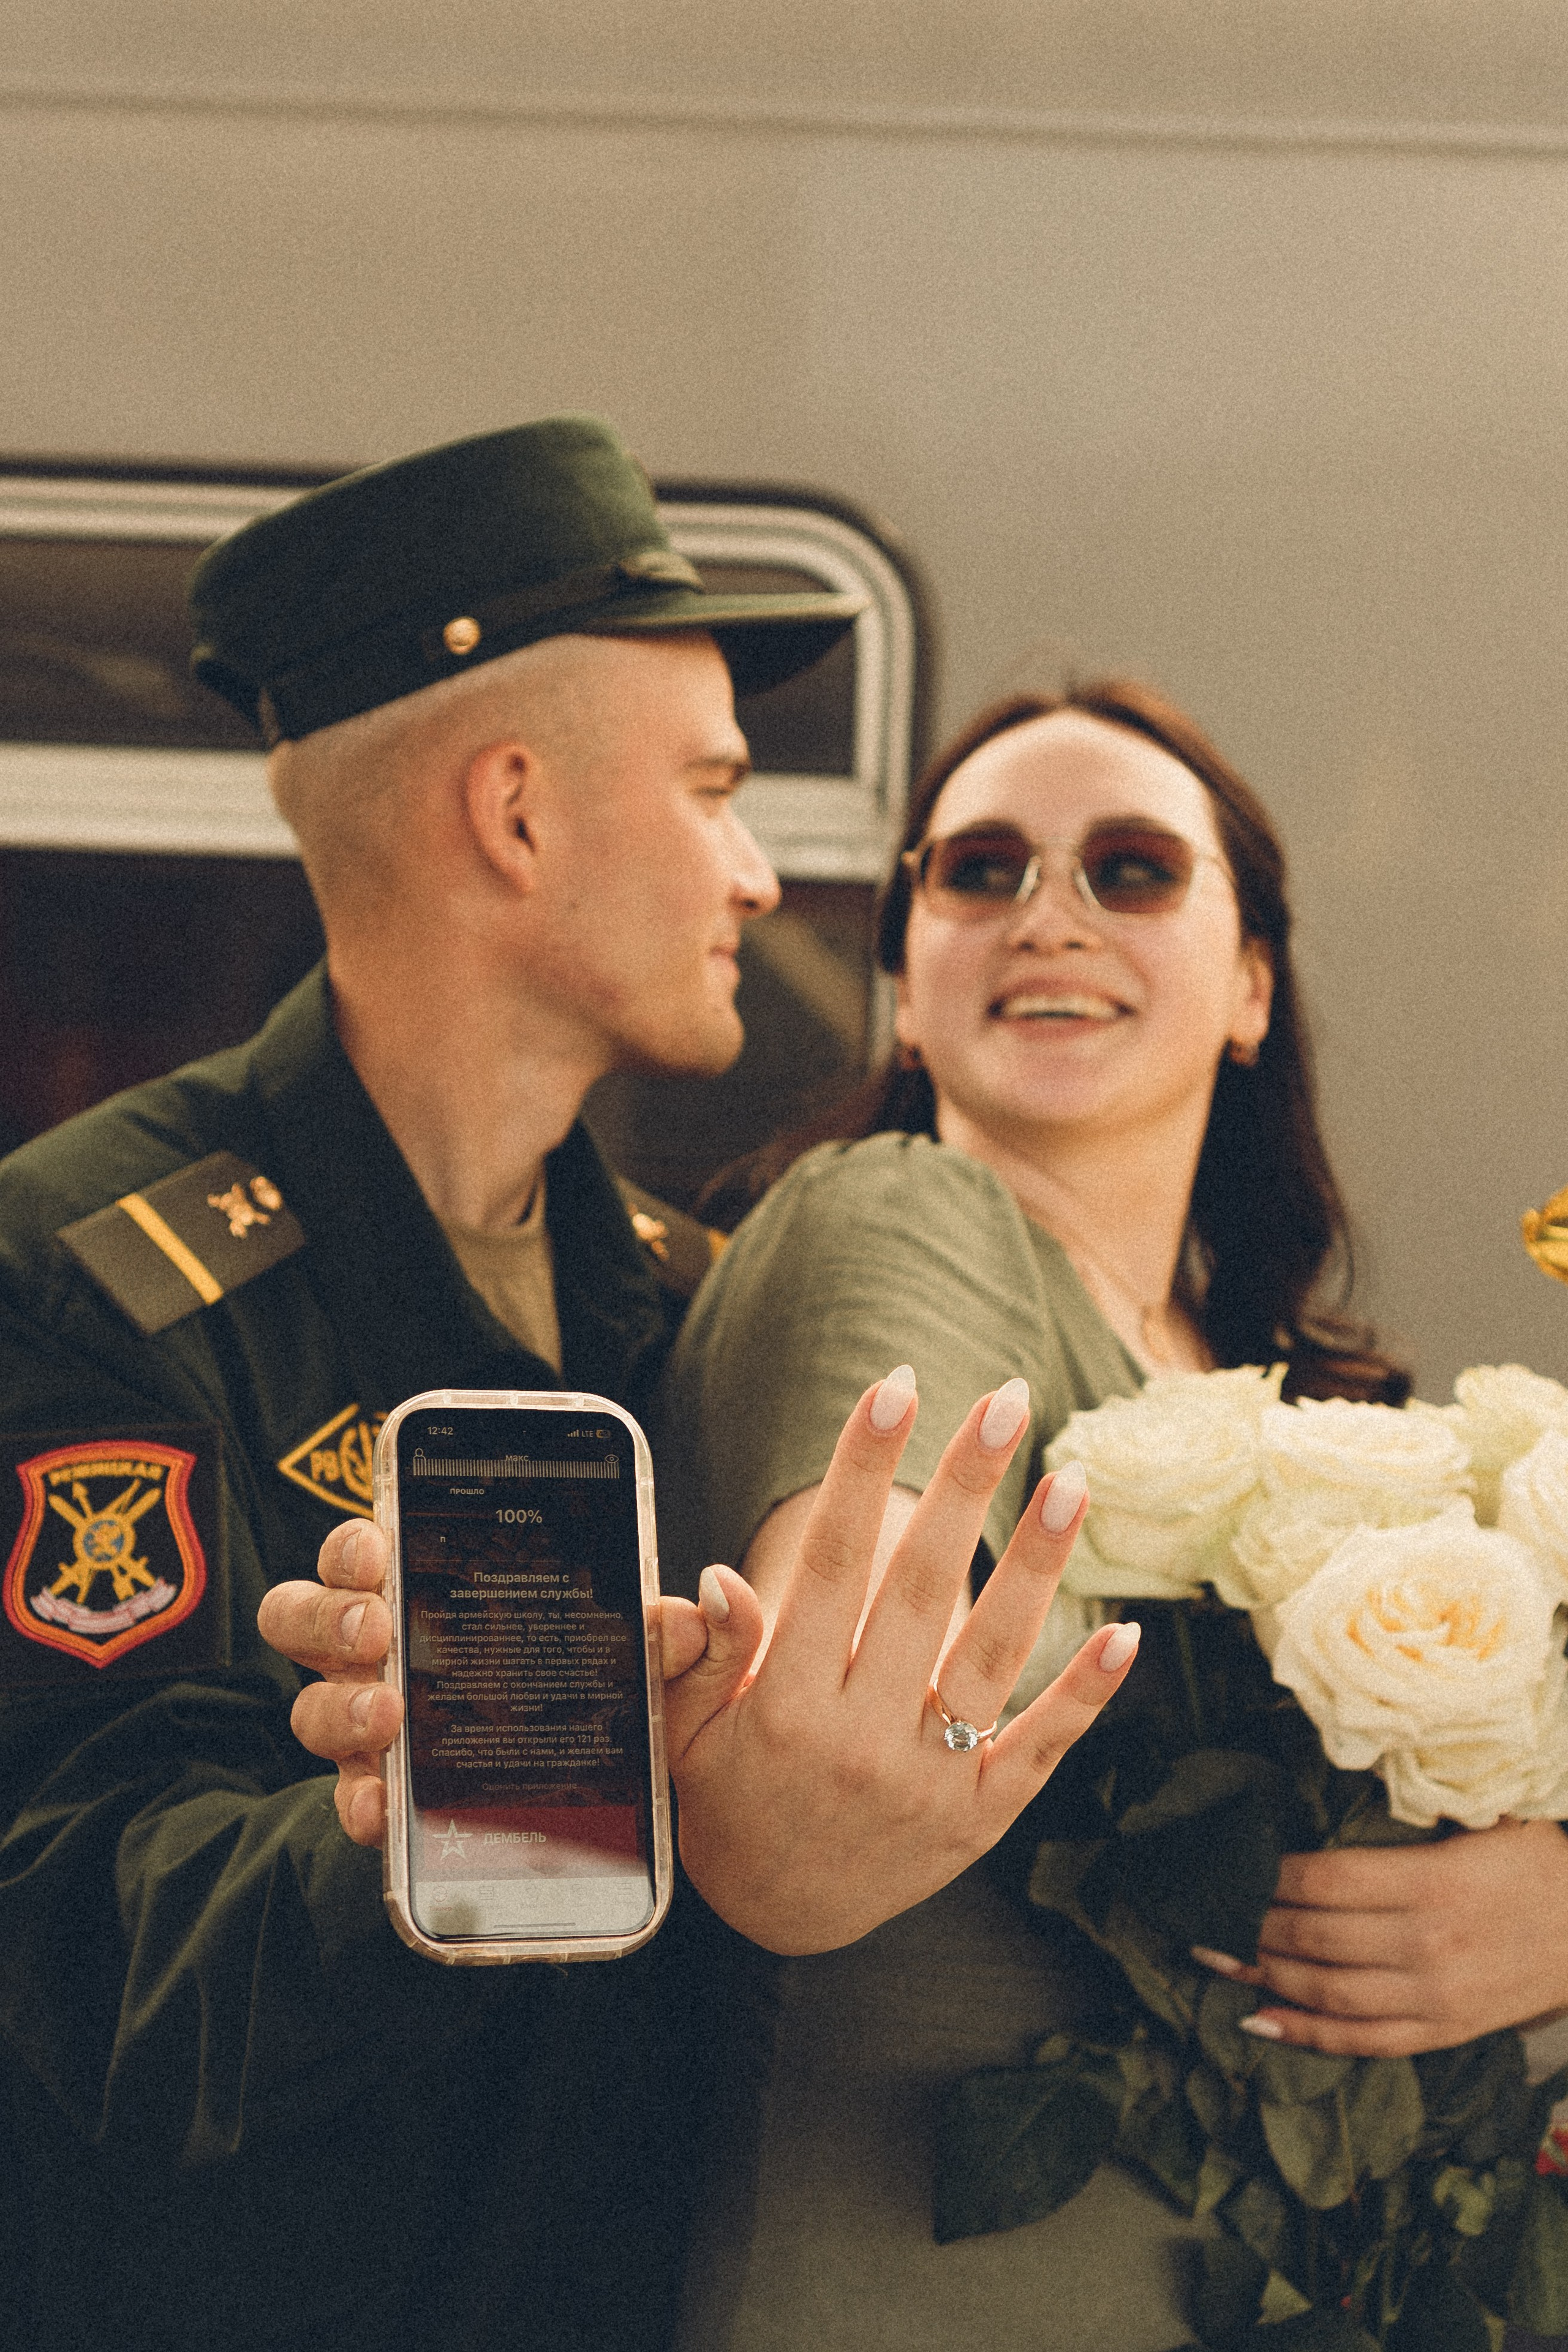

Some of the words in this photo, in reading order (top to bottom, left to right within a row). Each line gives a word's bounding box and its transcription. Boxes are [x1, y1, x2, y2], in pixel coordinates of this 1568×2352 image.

[427, 1426, 454, 1436] 12:42
[495, 1509, 543, 1524] 100%
[473, 1572, 560, 1585] Поздравляем
[562, 1574, 570, 1583] с
[450, 1588, 537, 1600] завершением
[540, 1588, 594, 1600] службы!
[420, 1610, 456, 1620] Пройдя
[458, 1610, 511, 1620] армейскую
[564, 1611, 624, 1620] несомненно,
[484, 1623, 526, 1632] сильнее,
[528, 1623, 577, 1632] увереннее
[419, 1634, 524, 1643] дисциплинированнее,
[538, 1635, 562, 1643] есть,
[564, 1634, 609, 1643] приобрел
[436, 1646, 482, 1655] качества,
[484, 1646, 521, 1656] нужные
[541, 1646, 565, 1655] того,
[567, 1645, 595, 1654] чтобы
[432, 1657, 469, 1667] мирной
[545, 1657, 579, 1666] первых
[581, 1657, 608, 1666] рядах
[496, 1670, 533, 1678] хранить
[437, 1681, 500, 1691] Поздравляем
[569, 1679, 605, 1689] службы
[467, 1692, 508, 1700] большой
[510, 1692, 540, 1700] любви
[551, 1692, 578, 1702] удачи
[587, 1691, 624, 1701] мирной
[510, 1703, 543, 1712] жизни!
[450, 1724, 462, 1733] За
[464, 1725, 494, 1733] время
[442, 1737, 500, 1746] приложения
[518, 1736, 558, 1745] открыли
[577, 1735, 592, 1743] 121
[594, 1735, 612, 1744] раз.
[431, 1748, 475, 1757] Спасибо,
[496, 1747, 521, 1756] были
[530, 1747, 557, 1757] нами,
[503, 1760, 531, 1770] удачи
[546, 1758, 600, 1768] гражданке!
[483, 1832, 546, 1845] ДЕМБЕЛЬ
